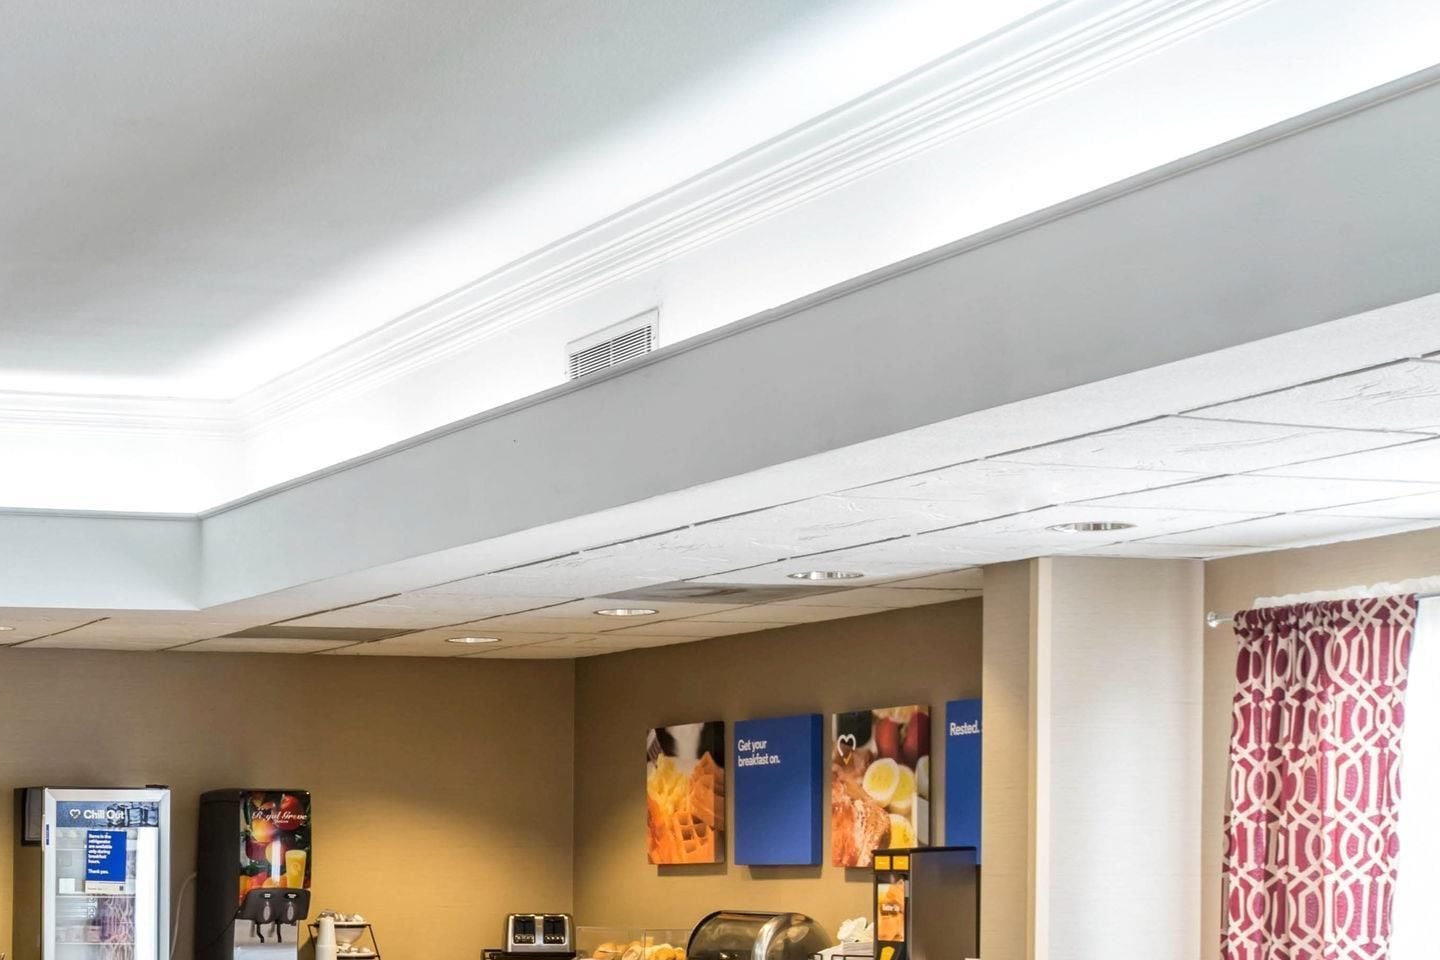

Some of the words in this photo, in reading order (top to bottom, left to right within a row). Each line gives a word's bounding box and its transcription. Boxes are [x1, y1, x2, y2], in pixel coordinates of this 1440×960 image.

[950, 720, 980, 736] Rested.
[738, 739, 751, 751] Get
[752, 740, 767, 752] your
[738, 753, 768, 767] breakfast
[769, 755, 781, 764] on.
[83, 809, 105, 819] Chill
[106, 809, 125, 820] Out
